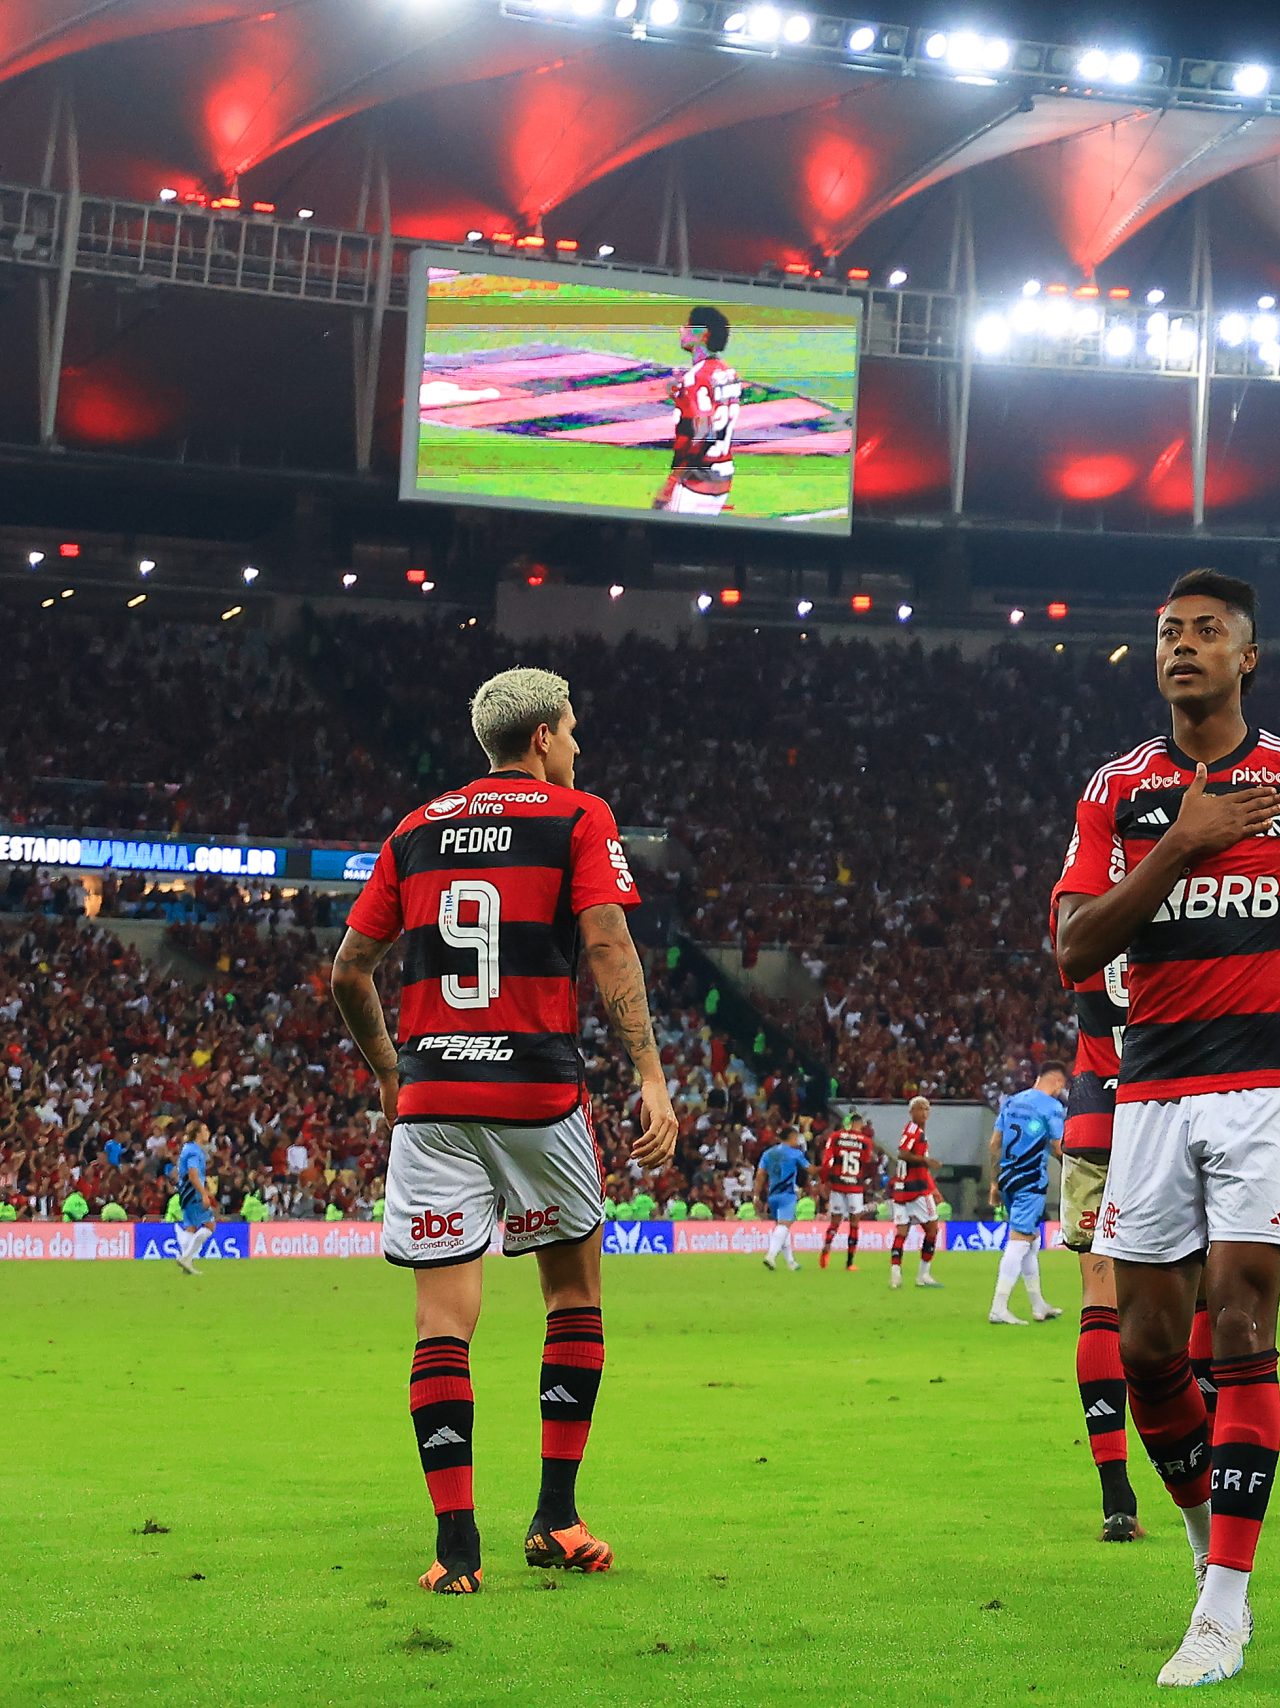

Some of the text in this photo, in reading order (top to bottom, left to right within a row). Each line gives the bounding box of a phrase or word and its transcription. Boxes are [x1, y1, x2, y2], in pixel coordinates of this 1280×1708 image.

[468, 802, 504, 816] livre
[472, 792, 548, 804] mercado
[440, 826, 512, 854] PEDRO
[445, 894, 453, 914] TIM
[1186, 876, 1280, 920] BRB
[439, 880, 501, 1010] 9
[417, 1035, 508, 1051] ASSIST
[441, 1048, 514, 1061] CARD
[840, 1150, 861, 1176] 15
[411, 1210, 464, 1240] abc
[506, 1206, 560, 1234] abc
[49, 1227, 73, 1257] do
[253, 1228, 376, 1258] A conta digital
[420, 1238, 464, 1250] construção
[691, 1231, 729, 1251] conta
[1211, 1468, 1266, 1493] CRF
